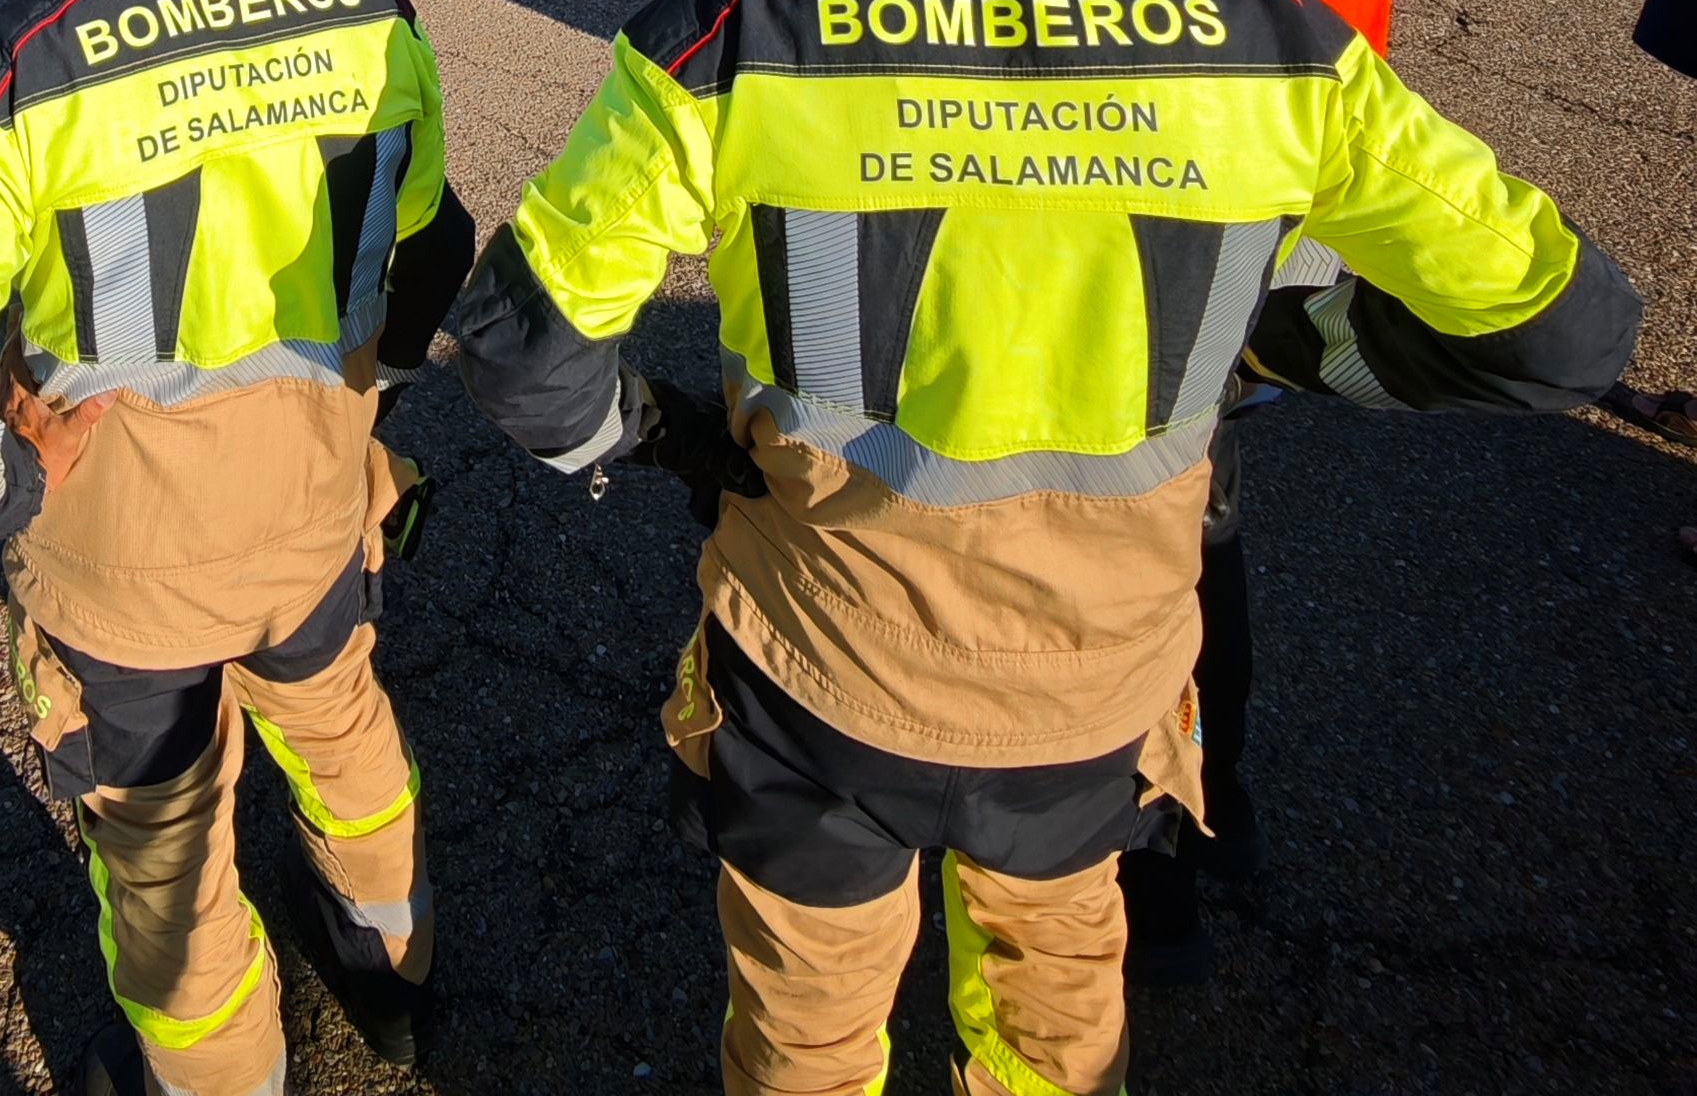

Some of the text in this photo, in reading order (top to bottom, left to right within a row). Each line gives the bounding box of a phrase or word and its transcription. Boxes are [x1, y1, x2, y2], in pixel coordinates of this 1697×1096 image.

[158, 46, 334, 107] DIPUTACIÓN
[136, 88, 369, 163] DE SALAMANCA
[896, 93, 1158, 133] DIPUTACIÓN
[860, 152, 1209, 190] DE SALAMANCA
